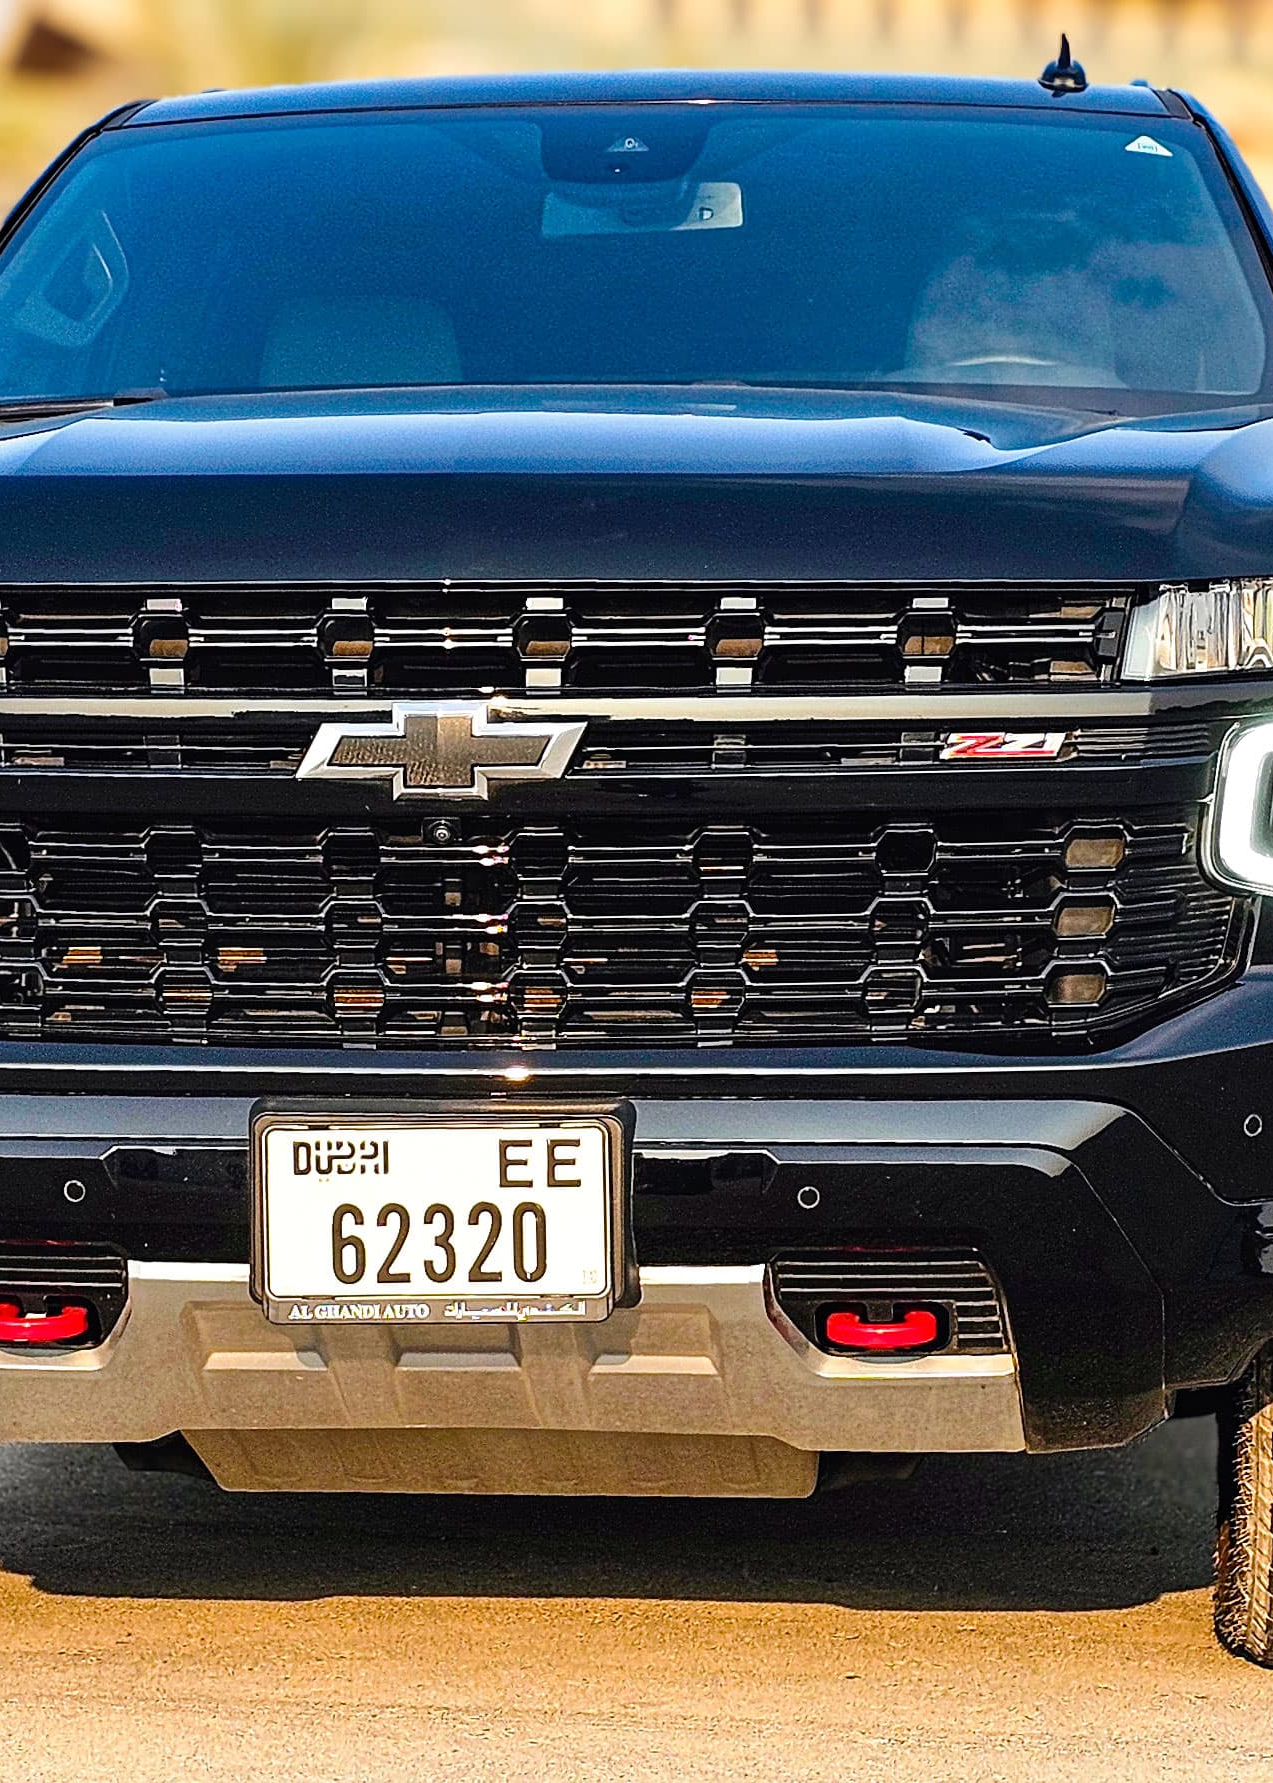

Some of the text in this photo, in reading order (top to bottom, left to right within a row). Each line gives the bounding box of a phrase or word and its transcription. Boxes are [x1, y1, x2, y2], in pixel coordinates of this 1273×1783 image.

[940, 731, 1067, 760] Z71
[292, 1140, 389, 1176] DUBAI
[331, 1201, 547, 1285] 62320
[288, 1303, 430, 1320] AL GHANDI AUTO
